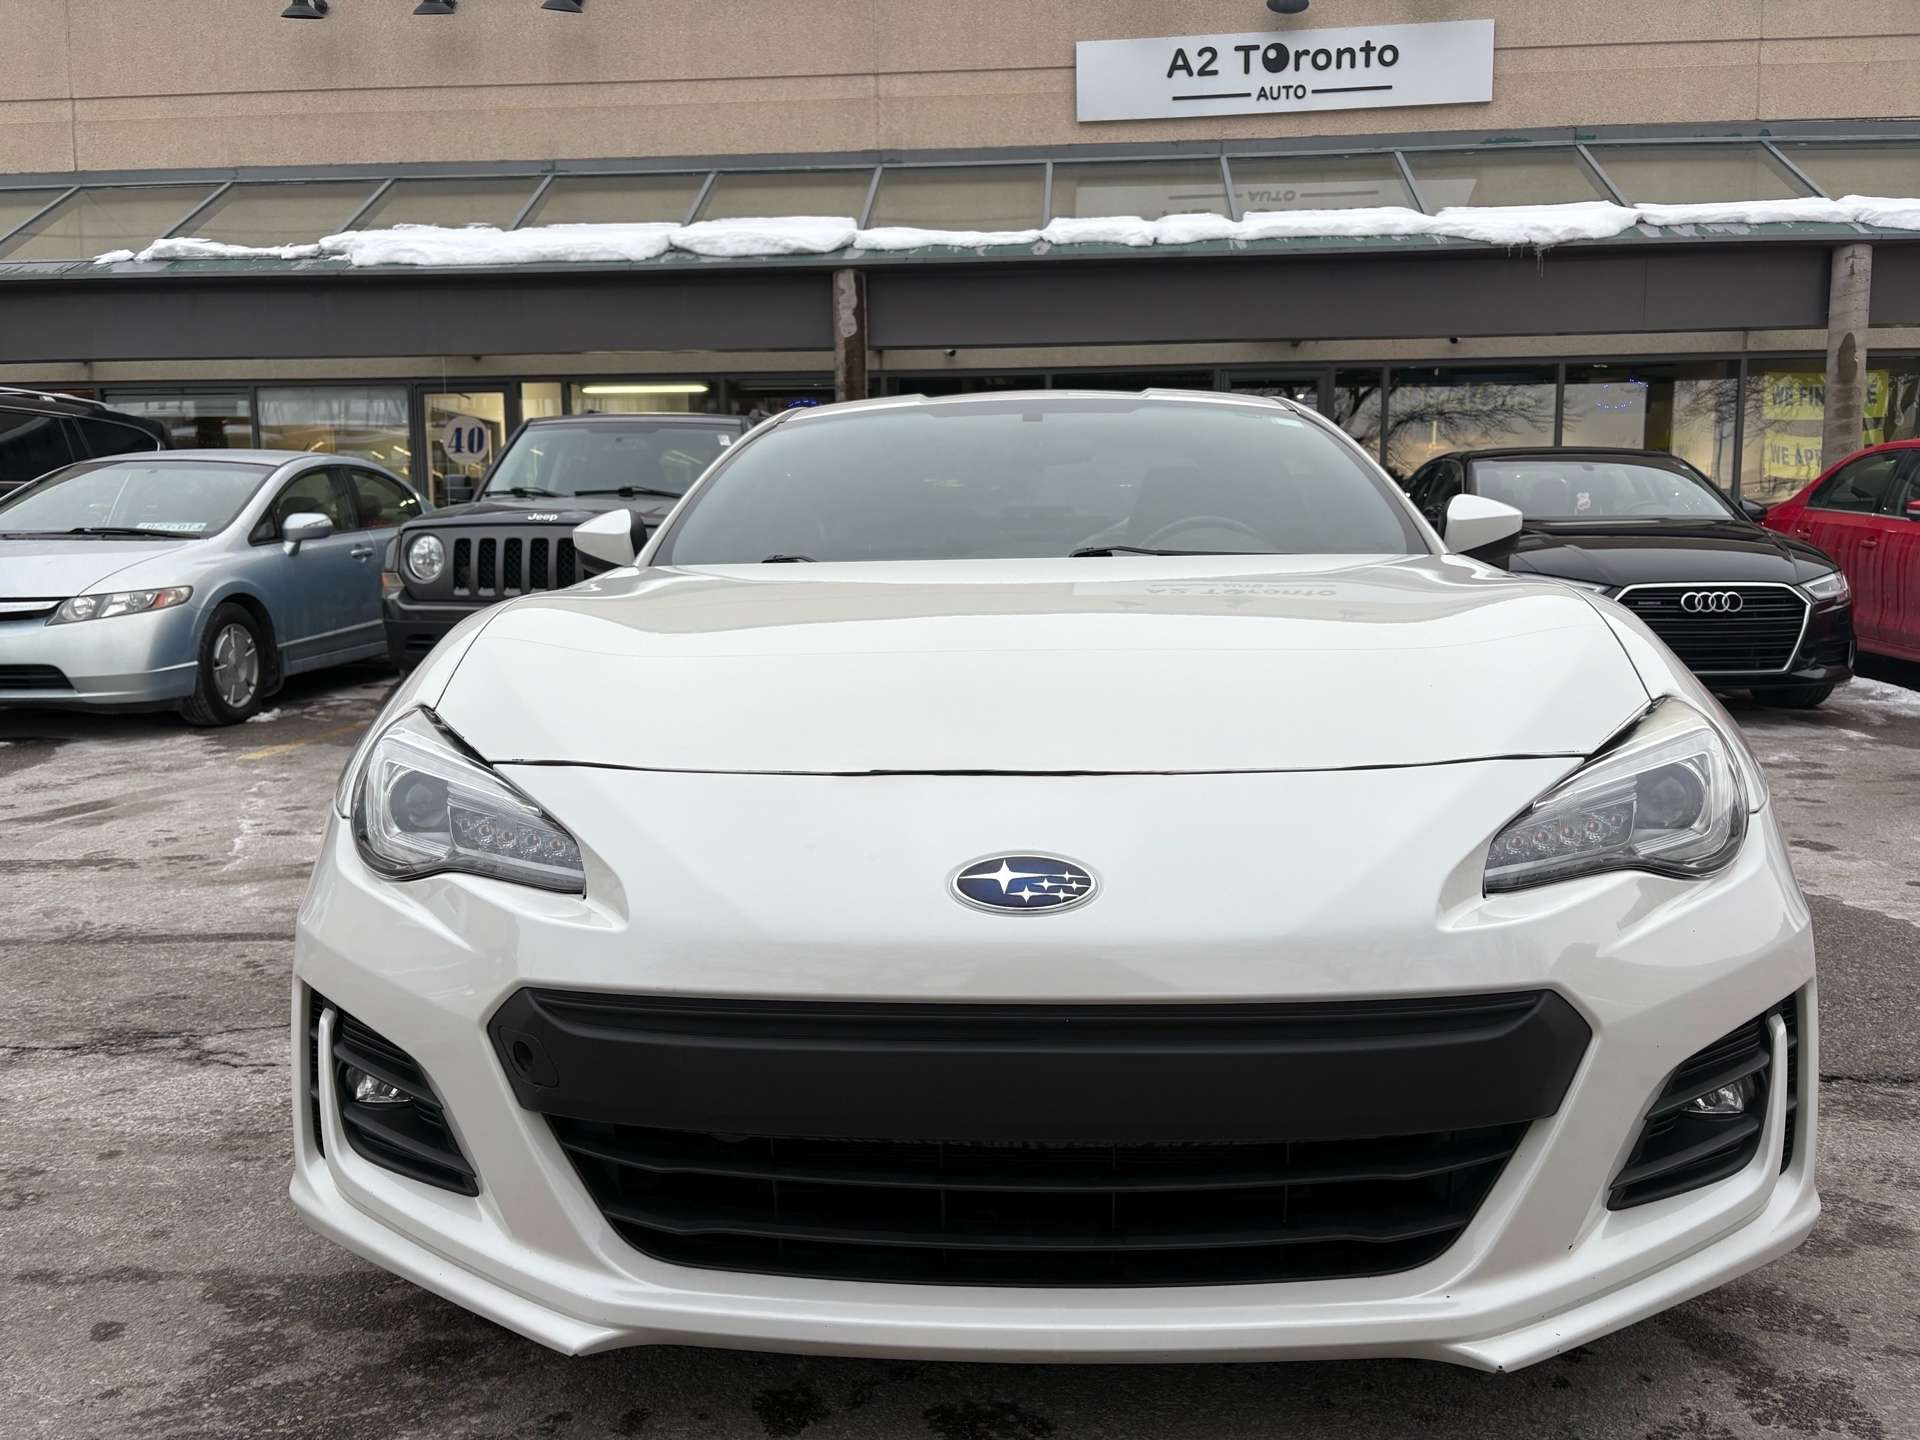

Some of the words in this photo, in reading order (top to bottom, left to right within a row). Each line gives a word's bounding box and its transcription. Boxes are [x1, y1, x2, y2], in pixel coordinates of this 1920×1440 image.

[1166, 46, 1219, 78] A2
[1255, 84, 1307, 101] AUTO
[1773, 383, 1794, 406] WE
[447, 427, 485, 454] 40
[527, 512, 558, 522] Jeep
